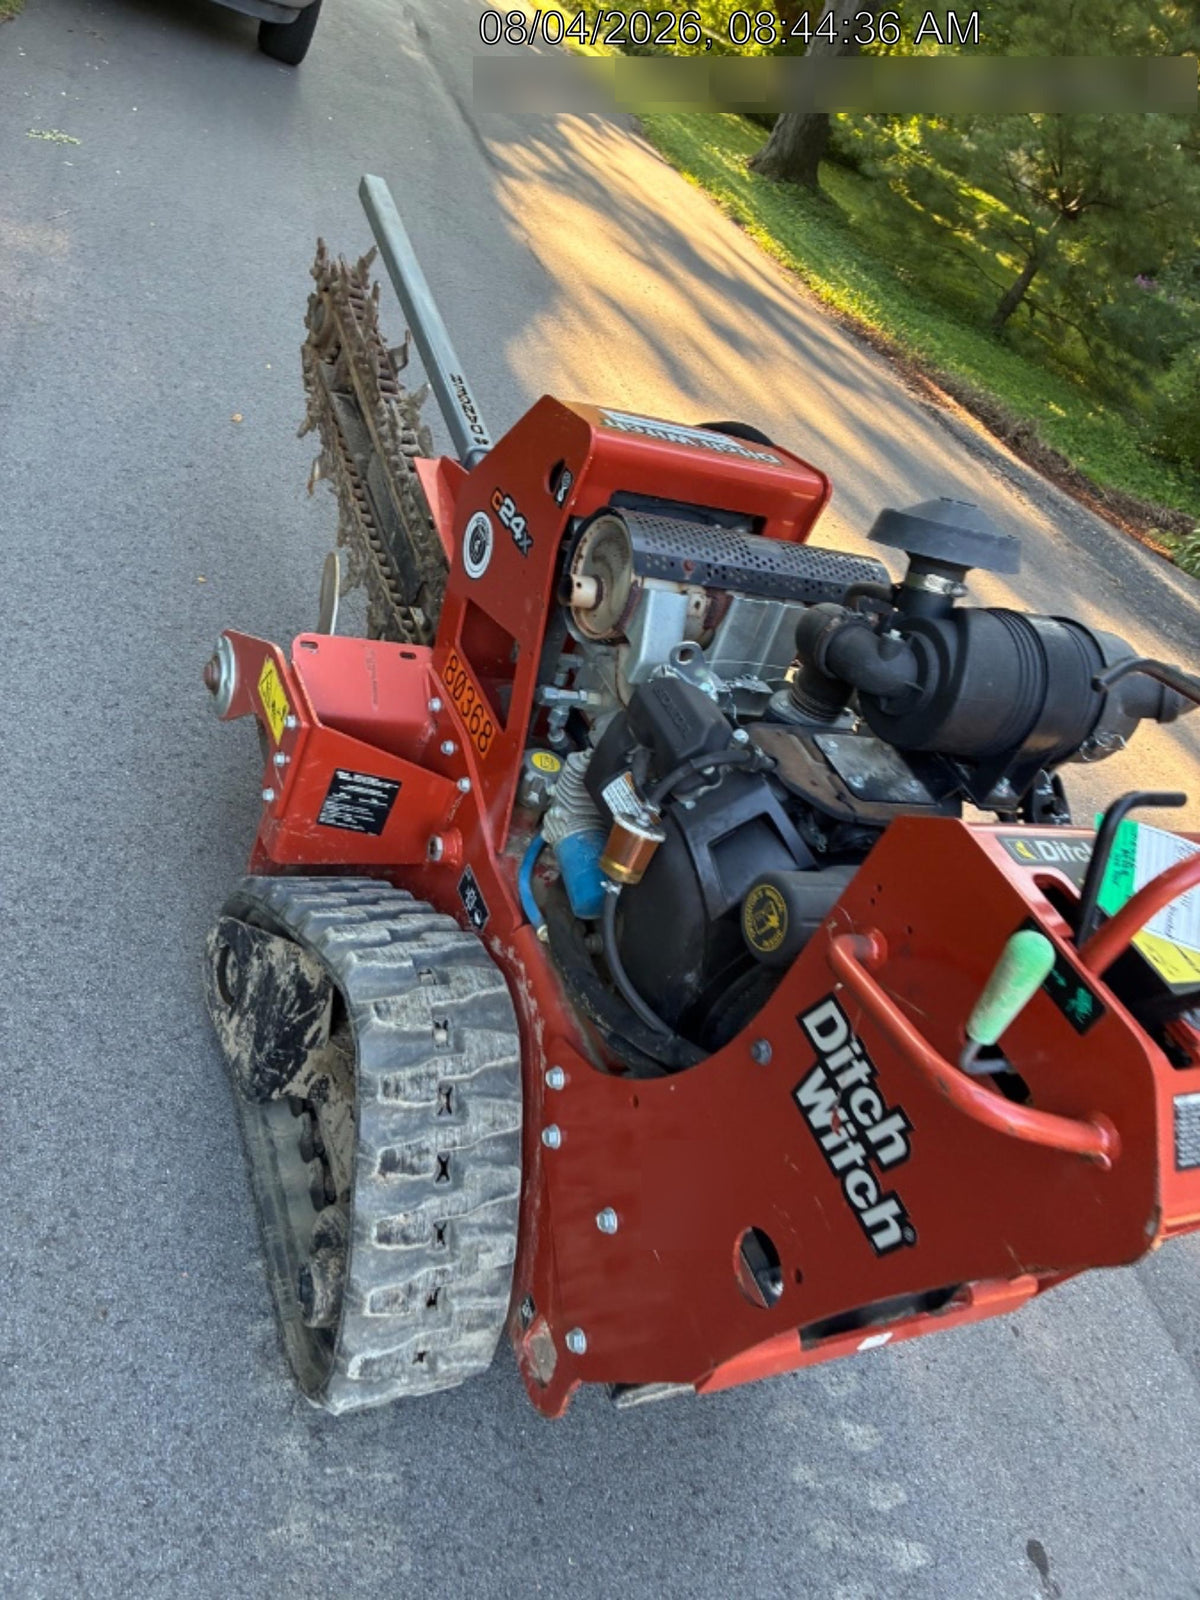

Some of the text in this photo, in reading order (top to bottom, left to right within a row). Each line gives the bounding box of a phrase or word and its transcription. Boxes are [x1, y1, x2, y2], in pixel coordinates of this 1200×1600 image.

[444, 654, 494, 753] 80368
[795, 1064, 904, 1251] Witch
[802, 998, 909, 1166] Ditch
